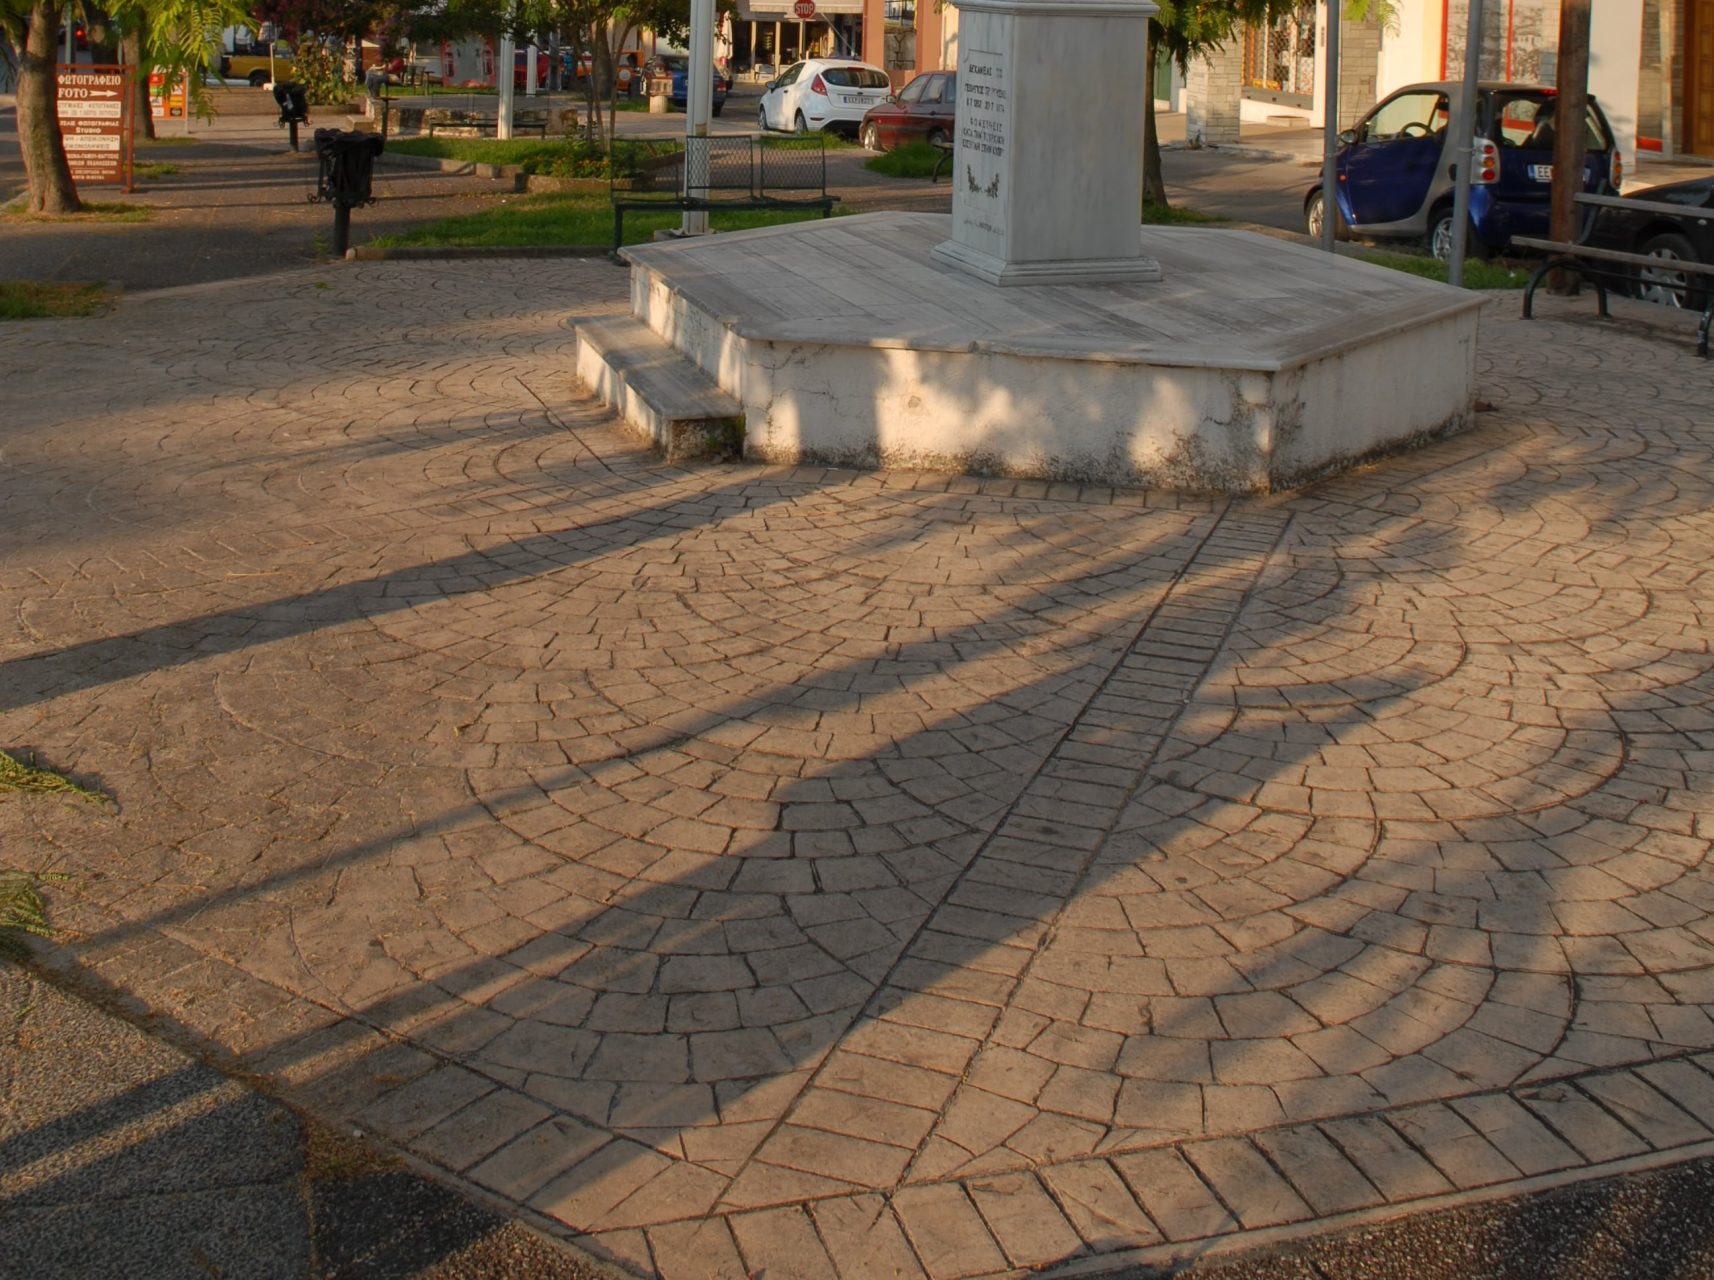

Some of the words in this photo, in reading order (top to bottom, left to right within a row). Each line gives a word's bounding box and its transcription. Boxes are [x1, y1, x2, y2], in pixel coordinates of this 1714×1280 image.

[795, 3, 814, 15] STOP
[58, 74, 121, 86] ΦΩΤΟΓΡΑΦΕΙΟ
[58, 87, 88, 98] FOTO
